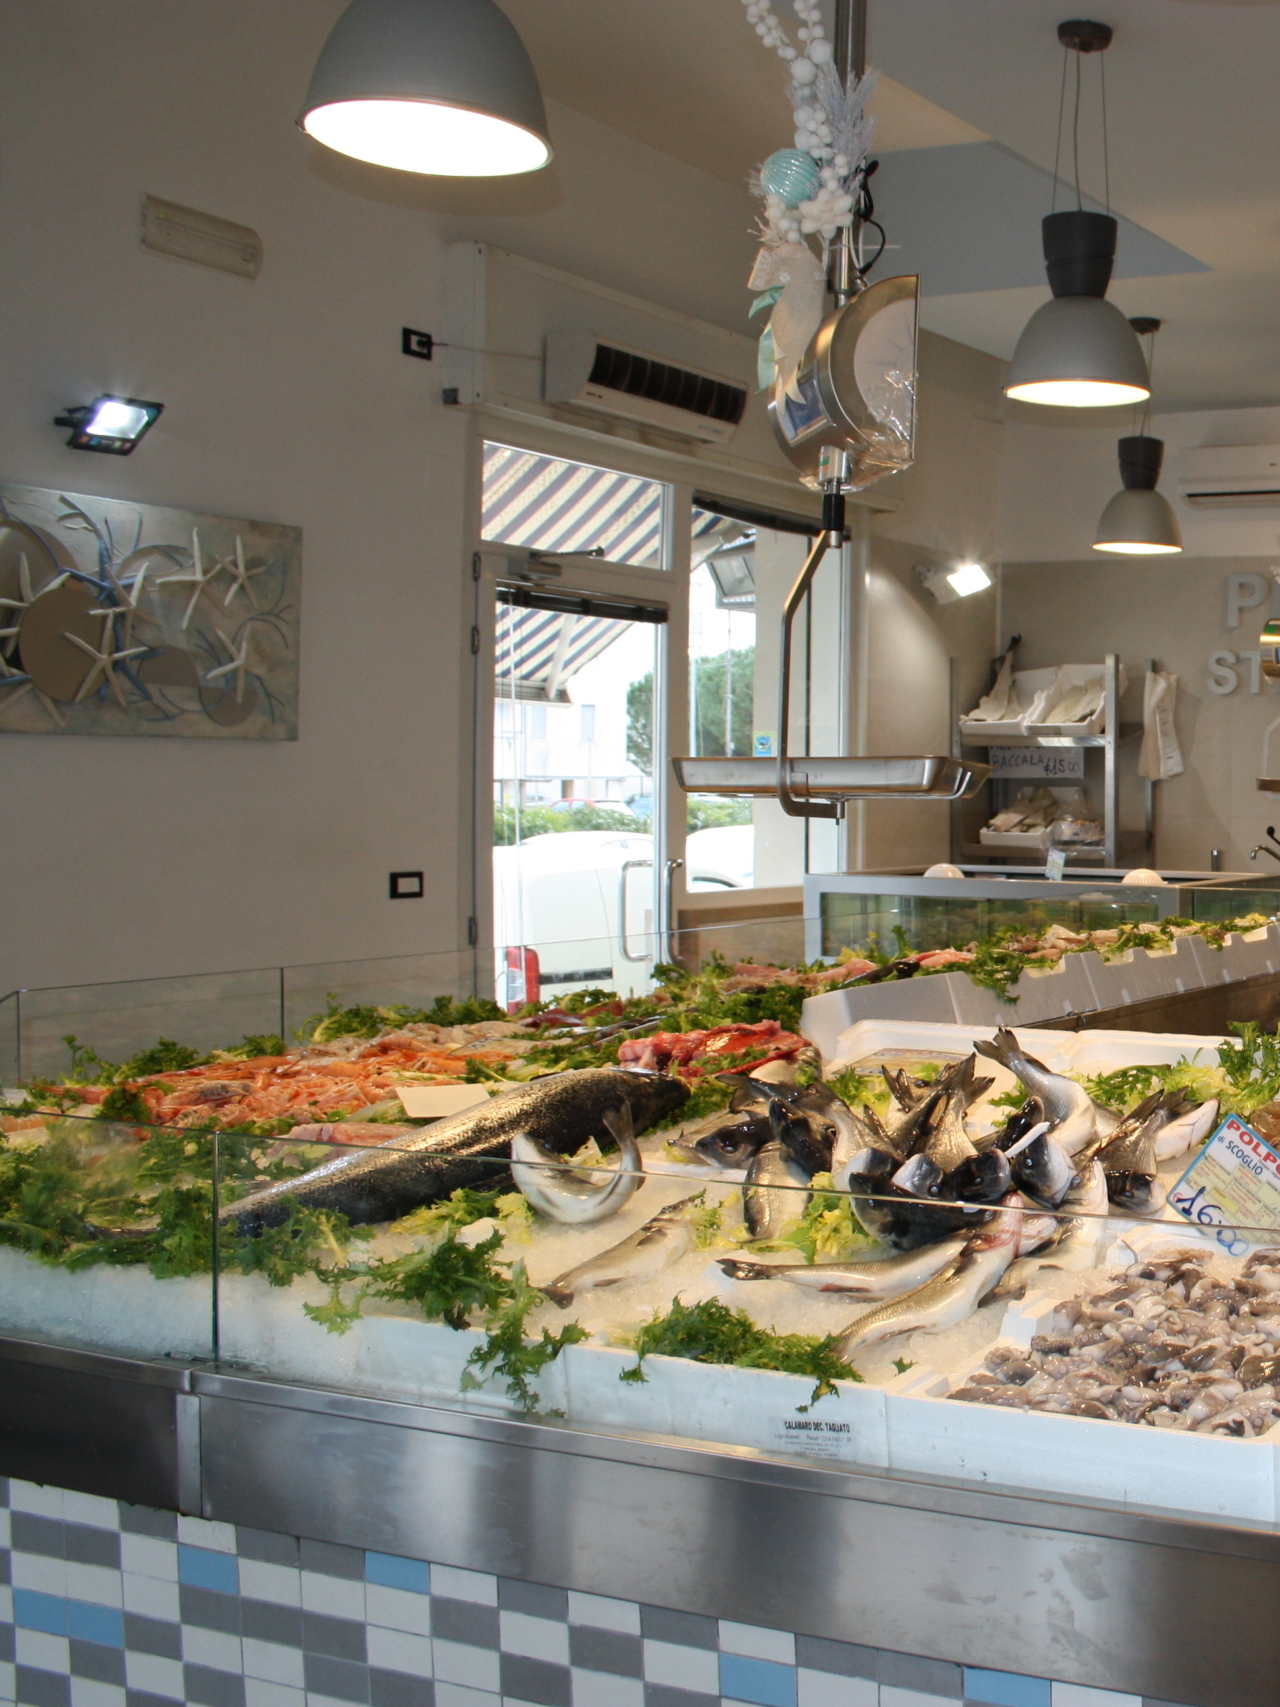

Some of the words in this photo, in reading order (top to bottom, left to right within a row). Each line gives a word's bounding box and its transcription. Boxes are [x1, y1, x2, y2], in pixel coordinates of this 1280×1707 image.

[1217, 1135, 1226, 1144] di
[1225, 1140, 1263, 1176] SCOGLIO
[784, 1420, 812, 1431] CALAMARO
[825, 1422, 850, 1433] TAGLIATO
